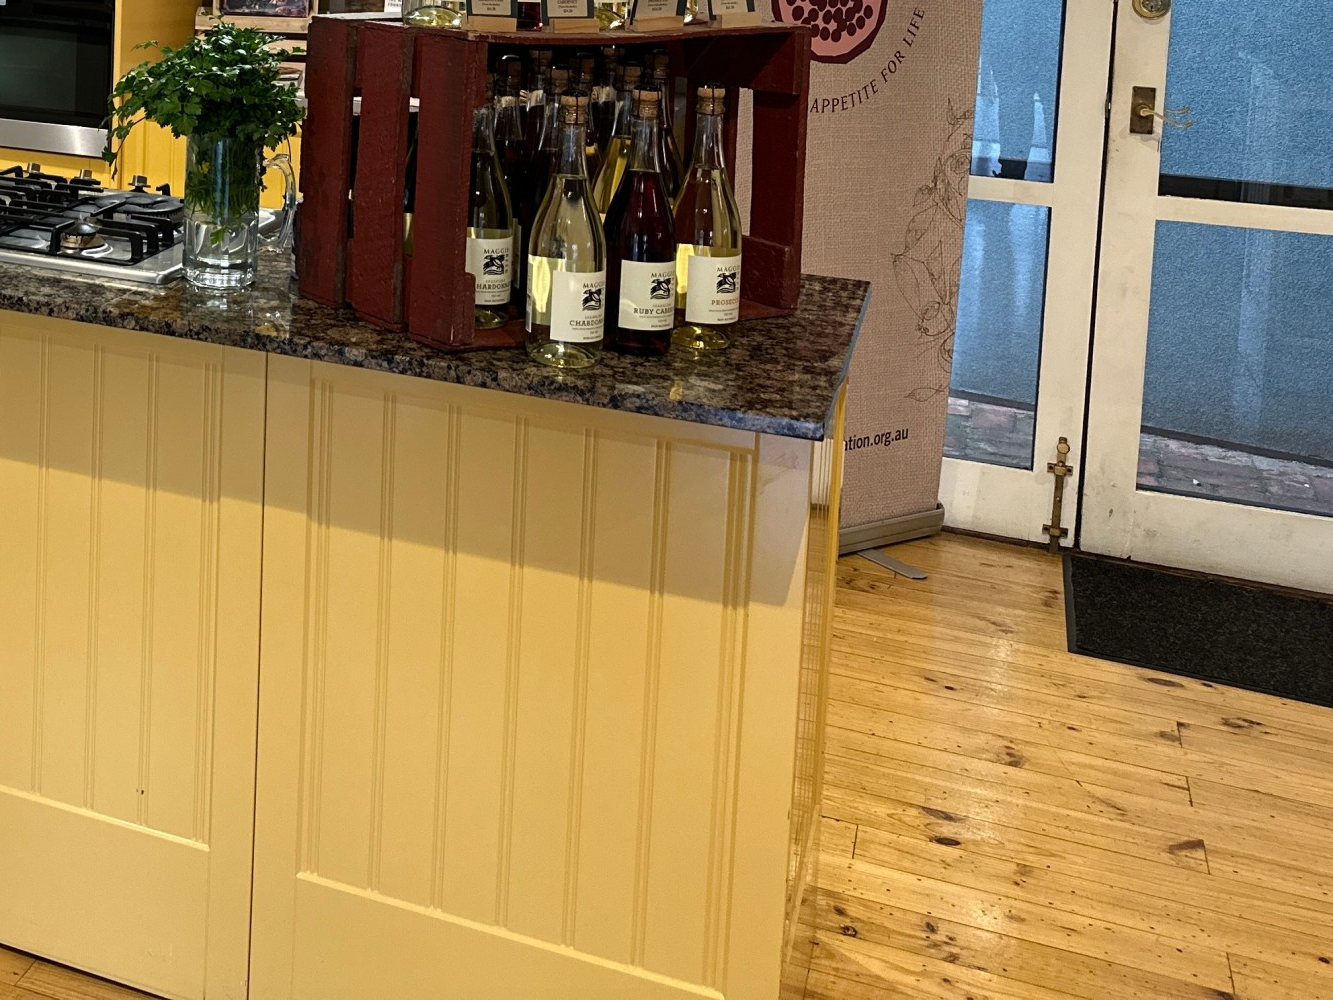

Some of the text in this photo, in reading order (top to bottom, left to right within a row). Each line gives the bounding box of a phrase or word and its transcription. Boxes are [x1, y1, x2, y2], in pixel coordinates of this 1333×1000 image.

[810, 7, 926, 114] APPETITE FOR LIFE
[633, 307, 654, 315] RUBY
